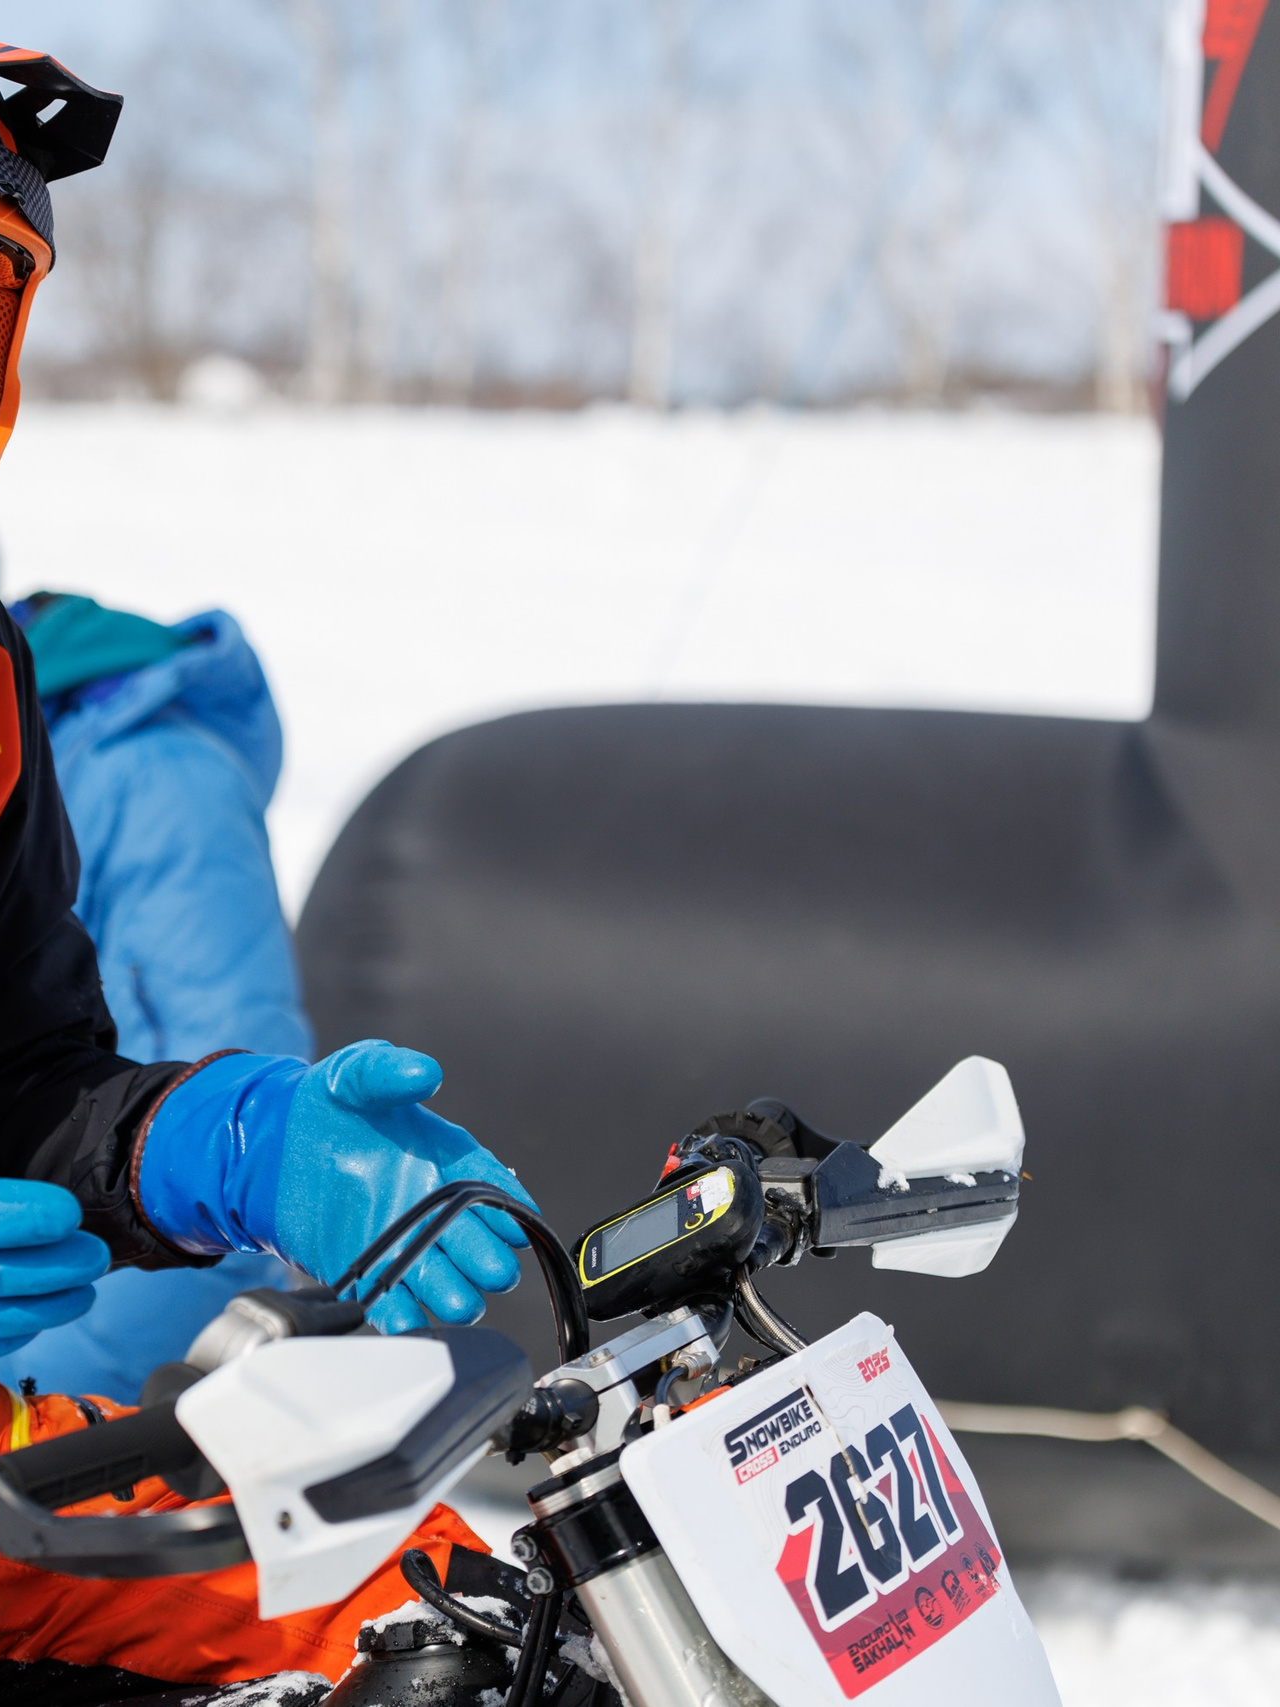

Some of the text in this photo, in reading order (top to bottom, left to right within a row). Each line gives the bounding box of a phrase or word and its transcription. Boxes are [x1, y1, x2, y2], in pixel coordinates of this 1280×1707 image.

[724, 1387, 813, 1468] SNOWBIKE
[736, 1420, 822, 1483] CROSS ENDURO
[784, 1402, 958, 1621] 2627
[846, 1621, 892, 1658] ENDURO
